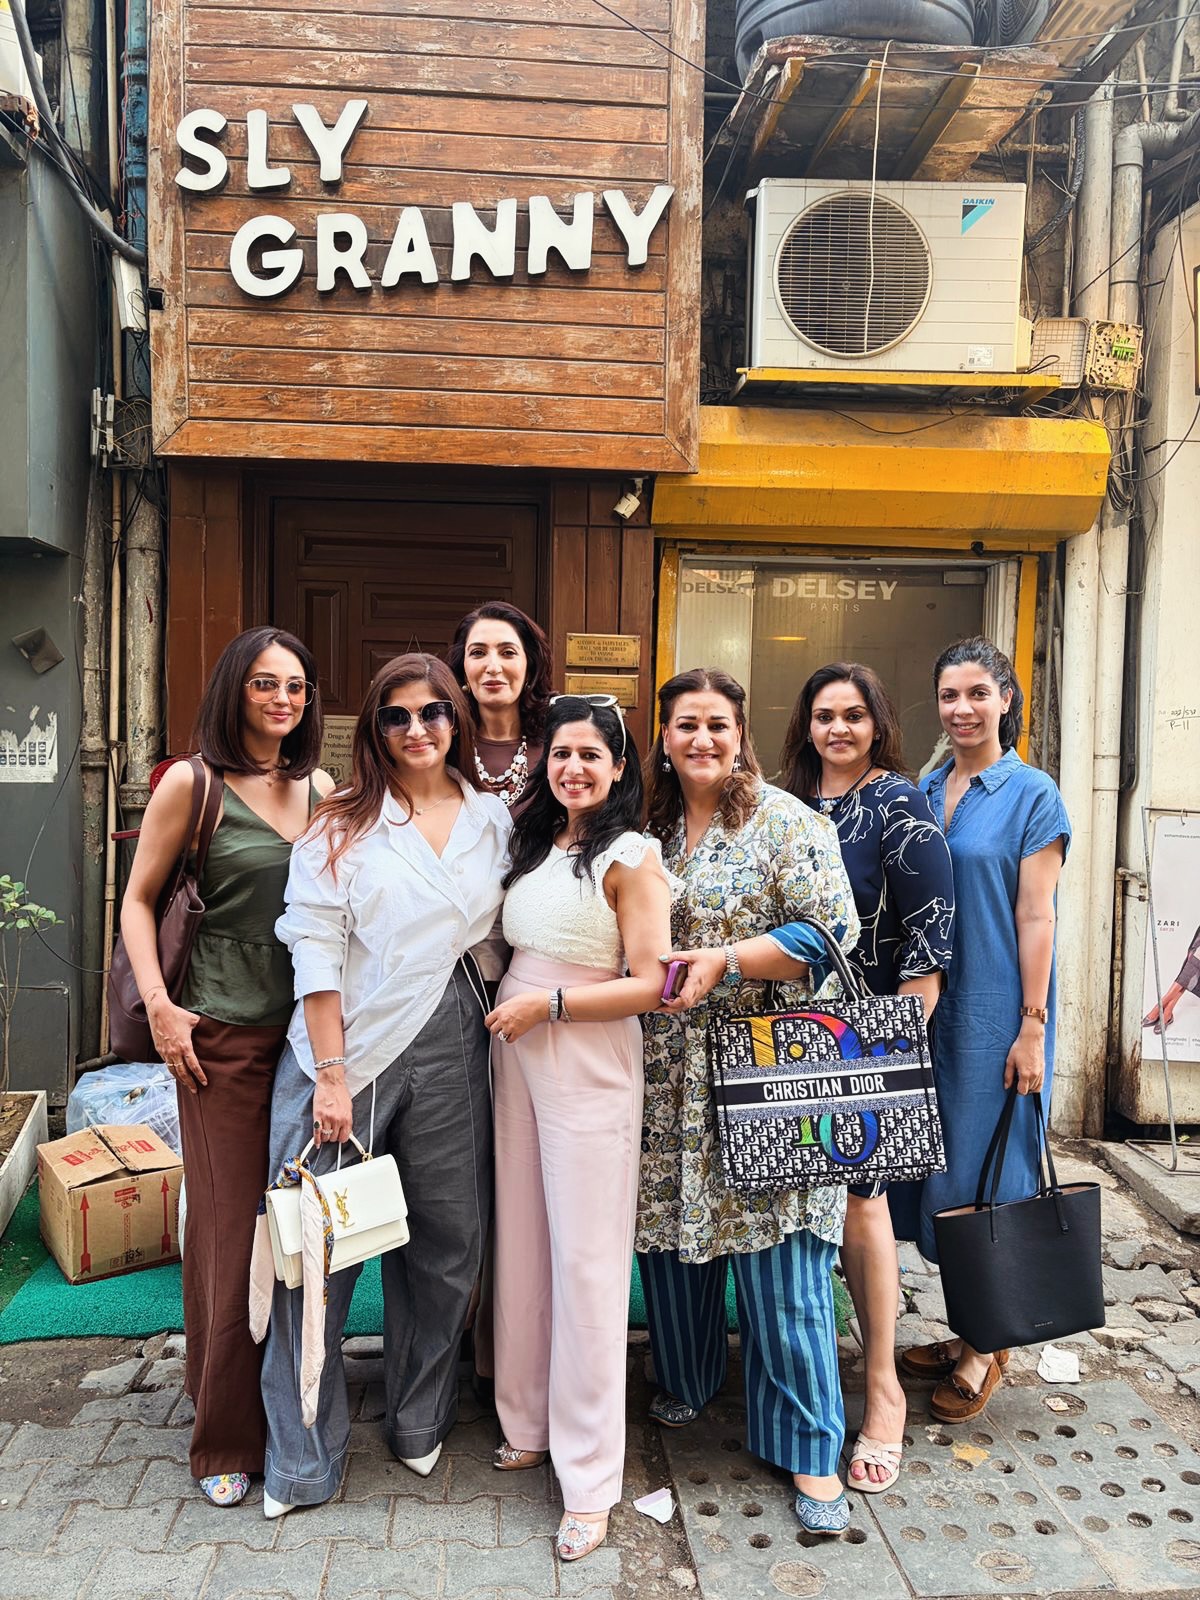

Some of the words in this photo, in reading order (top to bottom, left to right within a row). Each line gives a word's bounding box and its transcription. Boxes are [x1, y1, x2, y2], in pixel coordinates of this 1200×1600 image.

[174, 99, 368, 192] SLY
[962, 198, 996, 206] DAIKIN
[229, 185, 675, 298] GRANNY
[682, 582, 745, 594] DELSE
[772, 578, 898, 600] DELSEY
[810, 602, 860, 612] PARIS
[763, 1077, 843, 1100] CHRISTIAN
[850, 1074, 887, 1094] DIOR
